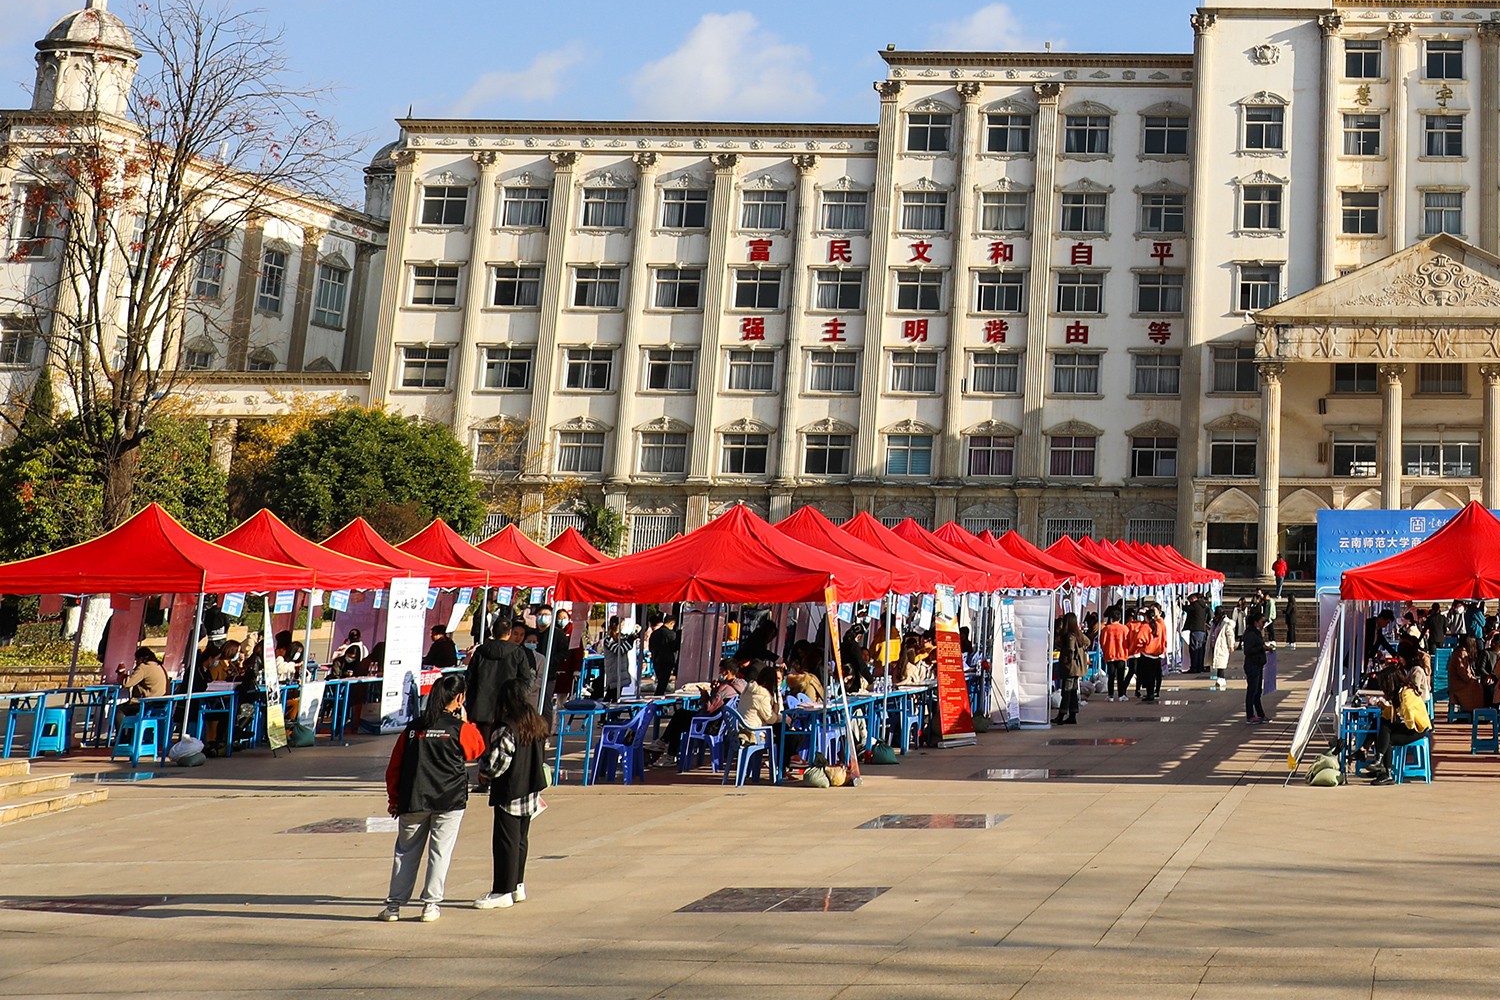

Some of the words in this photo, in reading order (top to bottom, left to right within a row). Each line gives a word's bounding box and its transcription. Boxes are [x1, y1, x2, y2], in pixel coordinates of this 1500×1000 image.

[1339, 537, 1427, 549] 云南师范大学商
